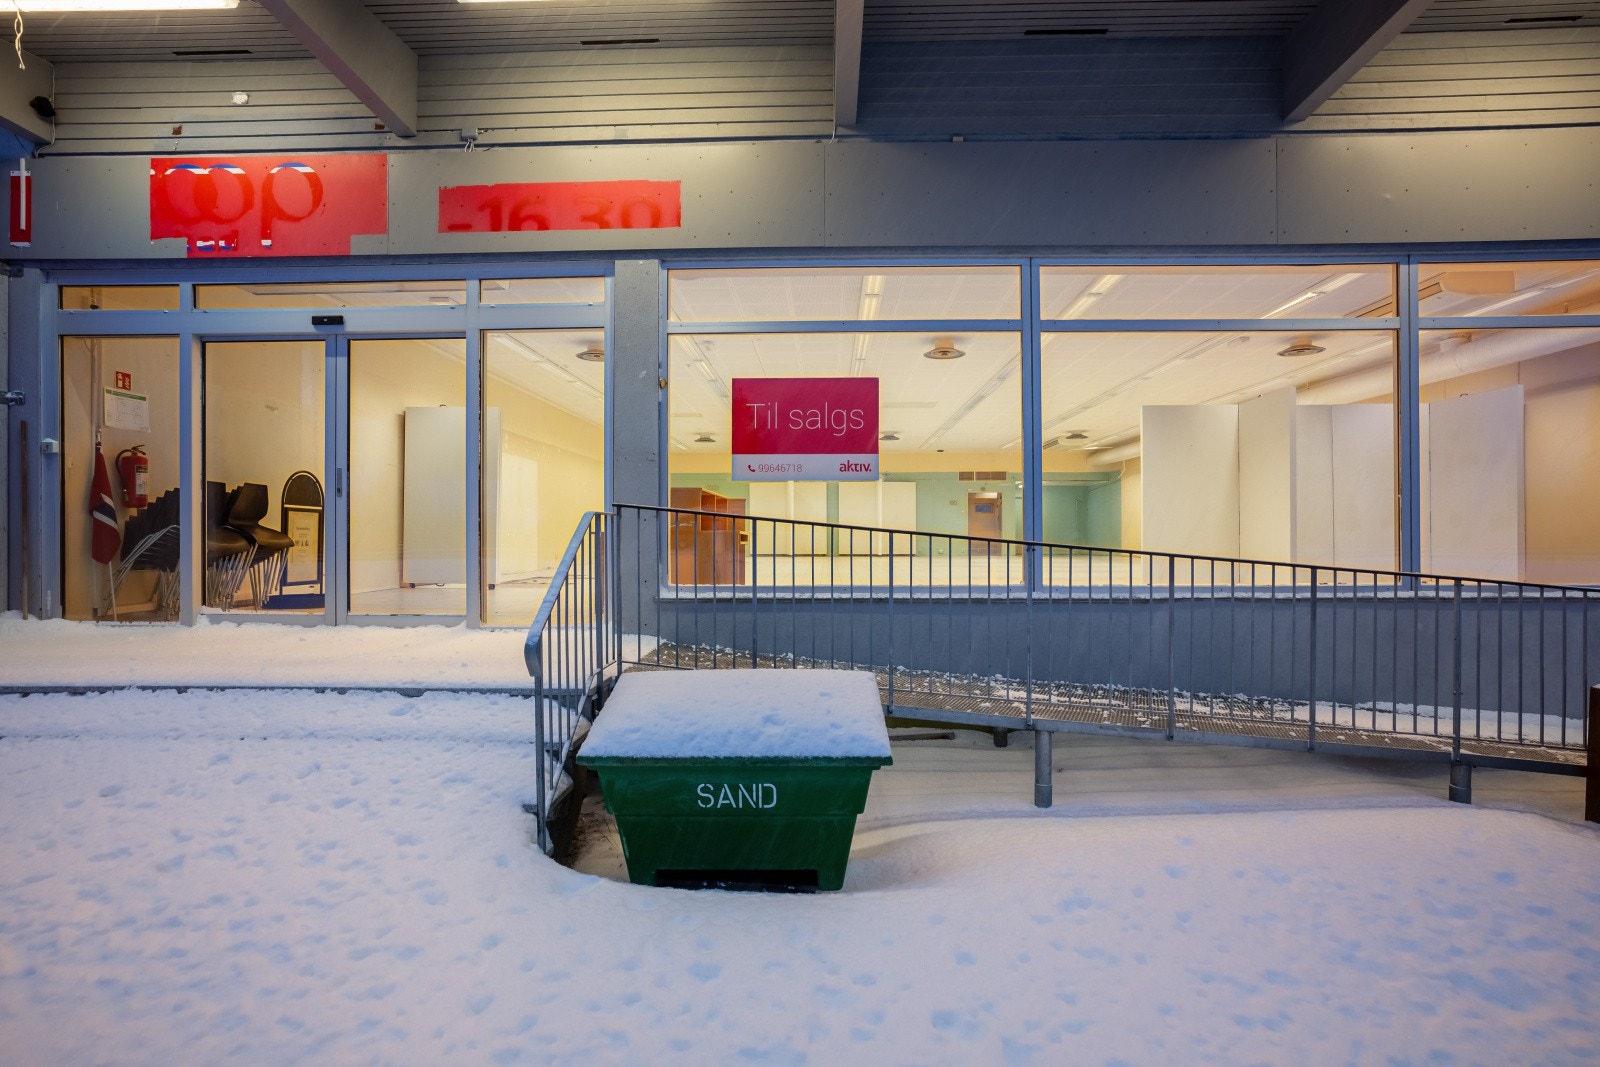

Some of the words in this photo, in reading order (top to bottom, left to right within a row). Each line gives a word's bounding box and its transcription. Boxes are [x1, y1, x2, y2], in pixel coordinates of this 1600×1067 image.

[745, 402, 778, 429] Til
[789, 402, 865, 437] salgs
[758, 463, 803, 473] 99646718
[697, 783, 777, 809] SAND
